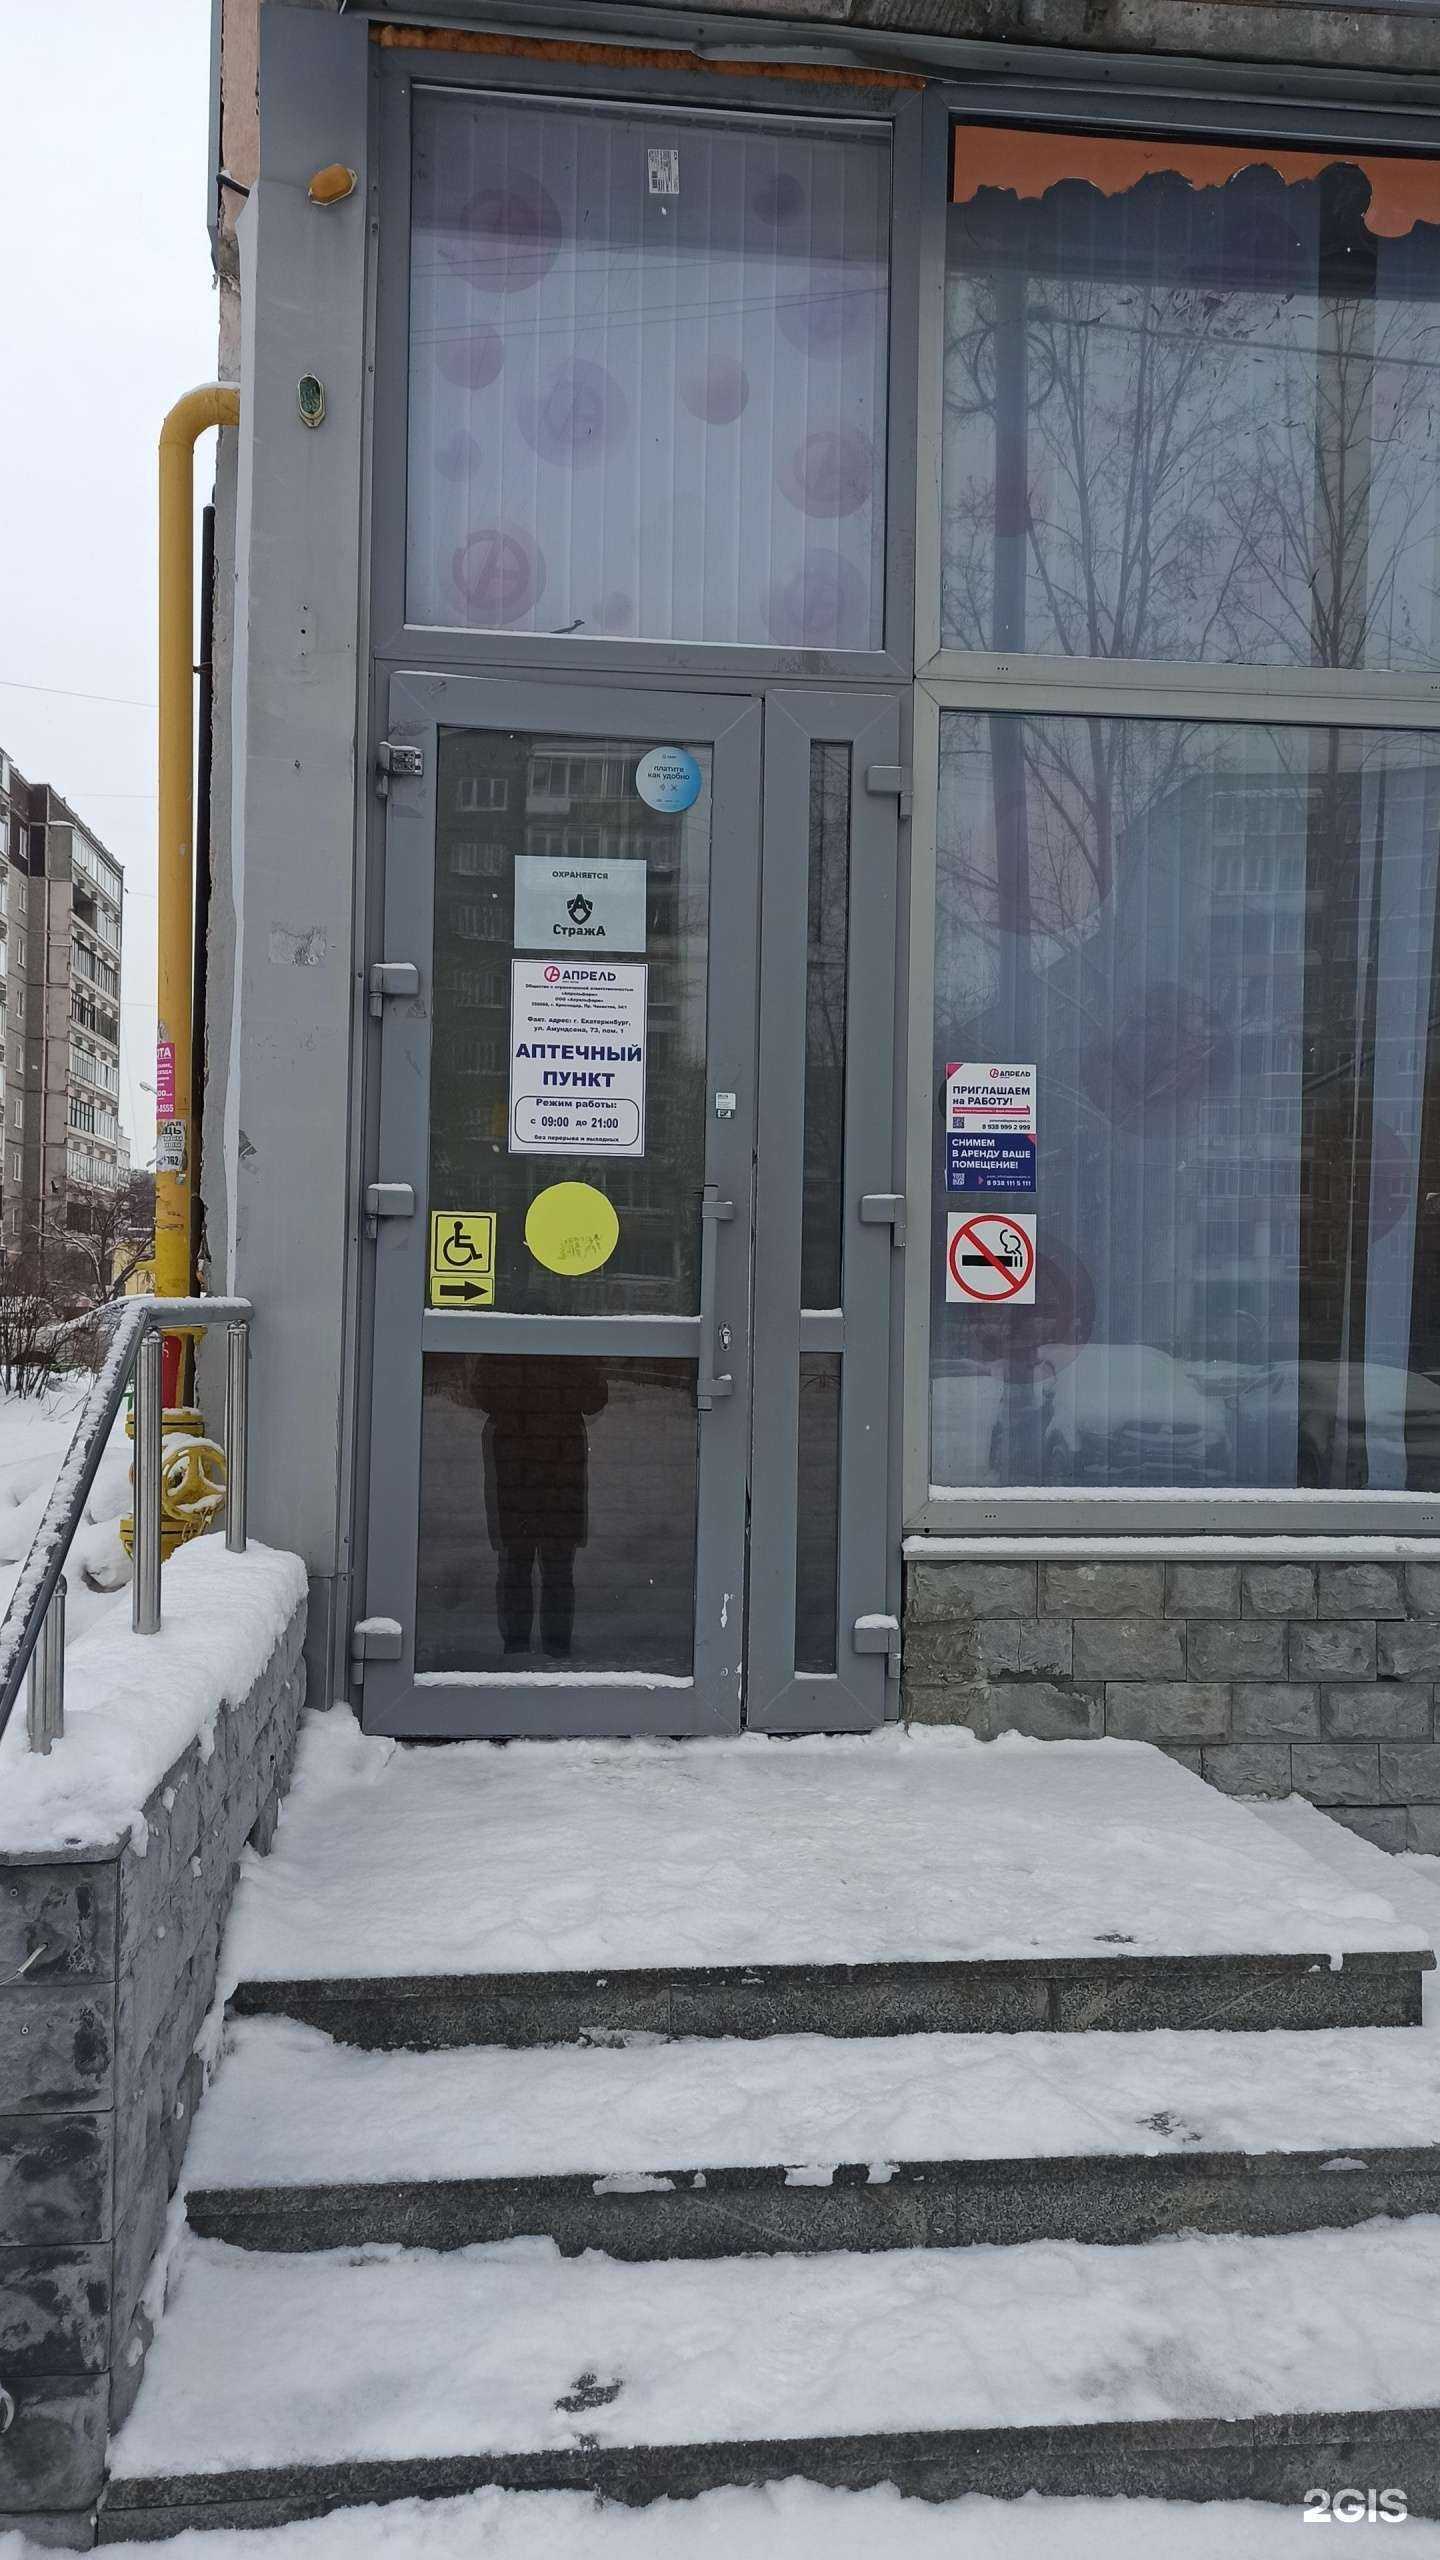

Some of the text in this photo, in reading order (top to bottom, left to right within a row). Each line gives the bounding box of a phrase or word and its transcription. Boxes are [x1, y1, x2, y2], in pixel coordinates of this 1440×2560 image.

[552, 871, 609, 880] ОХРАНЯЕТСЯ
[553, 924, 606, 938] СтражА
[562, 970, 616, 982] АПРЕЛЬ
[515, 1043, 642, 1062] АПТЕЧНЫЙ
[543, 1070, 616, 1088] ПУНКТ
[952, 1086, 1030, 1095] ПРИГЛАШАЕМ
[536, 1098, 617, 1110] Режим работы:
[967, 1097, 1013, 1106] РАБОТУ!
[541, 1116, 569, 1127] 09:00
[575, 1119, 588, 1128] до
[591, 1117, 619, 1129] 21:00
[952, 1138, 995, 1147] СНИМЕМ
[952, 1149, 1031, 1159] В АРЕНДУ ВАШЕ
[952, 1160, 1018, 1170] ПОМЕЩЕНИЕ!
